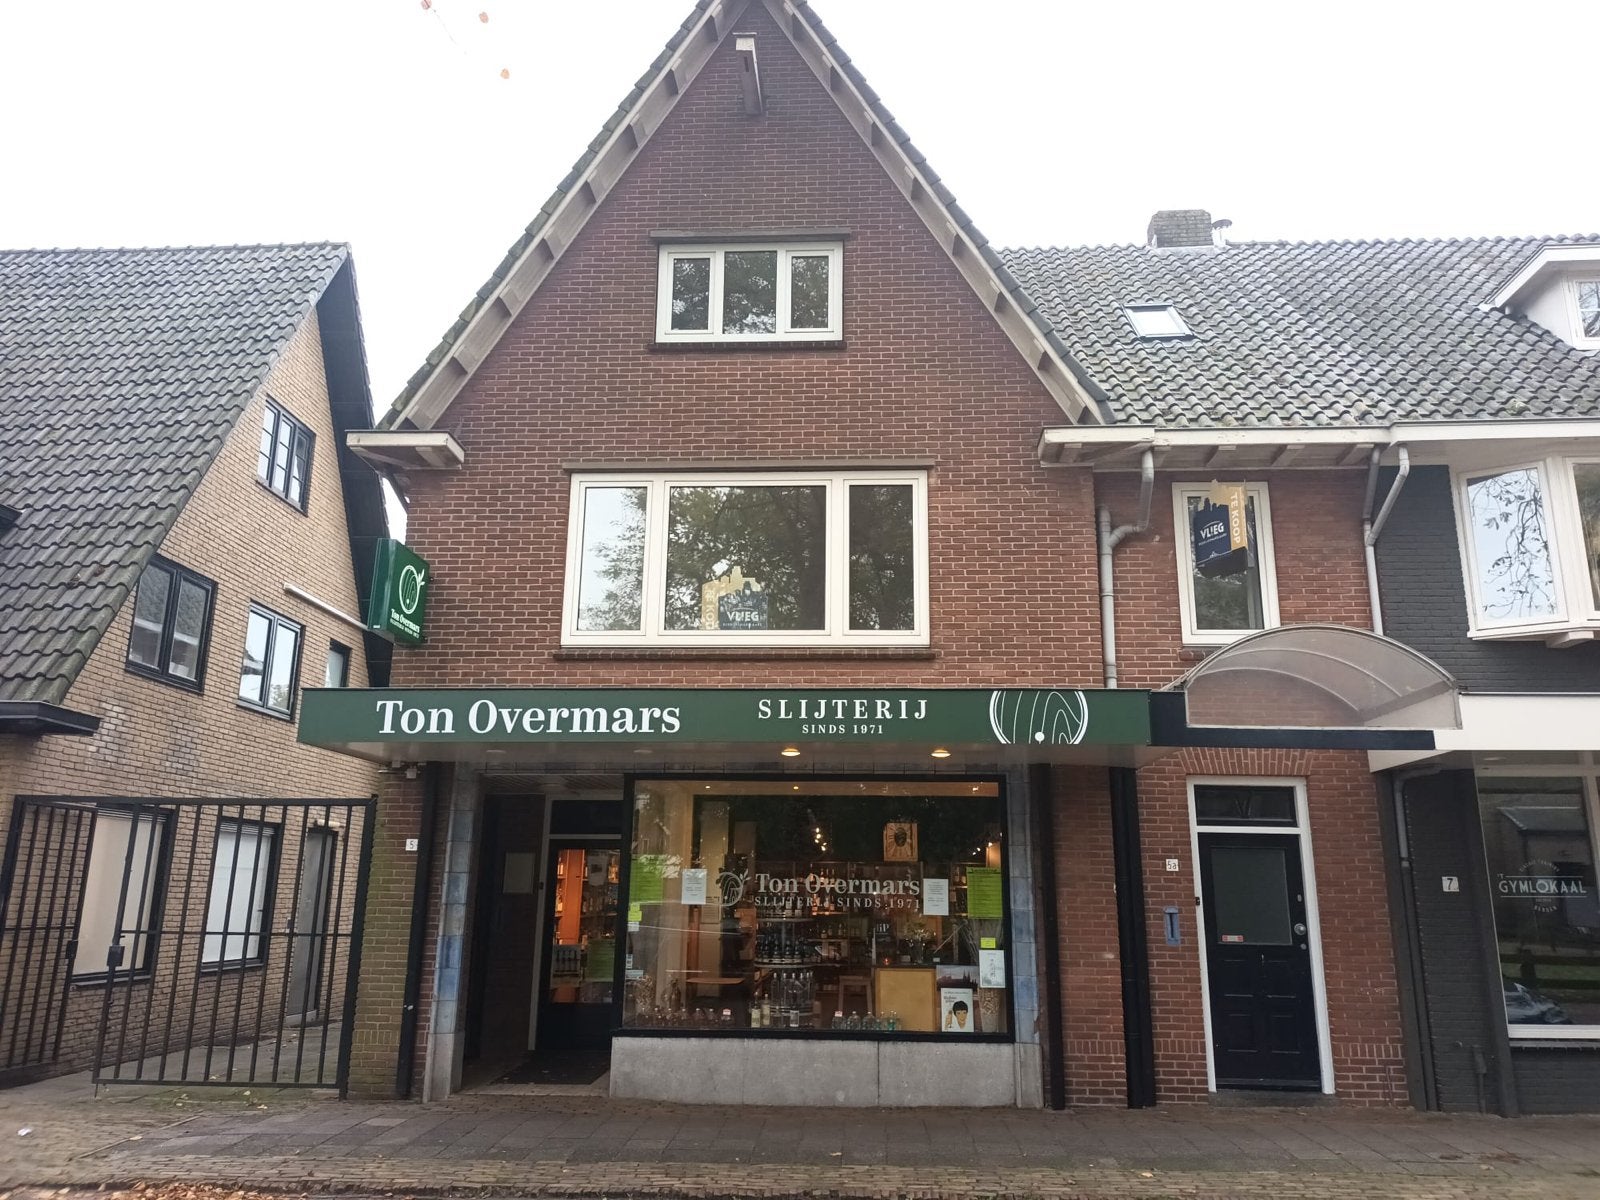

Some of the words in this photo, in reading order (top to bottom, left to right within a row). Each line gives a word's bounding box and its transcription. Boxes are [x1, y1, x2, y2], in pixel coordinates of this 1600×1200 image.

[1230, 491, 1238, 507] TE
[1200, 522, 1225, 539] VLIEG
[1231, 510, 1241, 544] KOOP
[376, 700, 455, 734] Ton
[468, 699, 681, 734] Overmars
[758, 699, 928, 719] SLIJTERIJ
[802, 724, 846, 734] SINDS
[853, 724, 883, 734] 1971
[1167, 860, 1177, 870] 5a
[755, 873, 798, 893] Ton
[805, 873, 921, 895] Overmars
[1446, 877, 1454, 890] 7
[1498, 880, 1587, 894] GYMLOKAAL
[754, 896, 829, 907] SLIJTERIJ
[837, 897, 881, 907] SINDS
[889, 898, 921, 909] 1971
